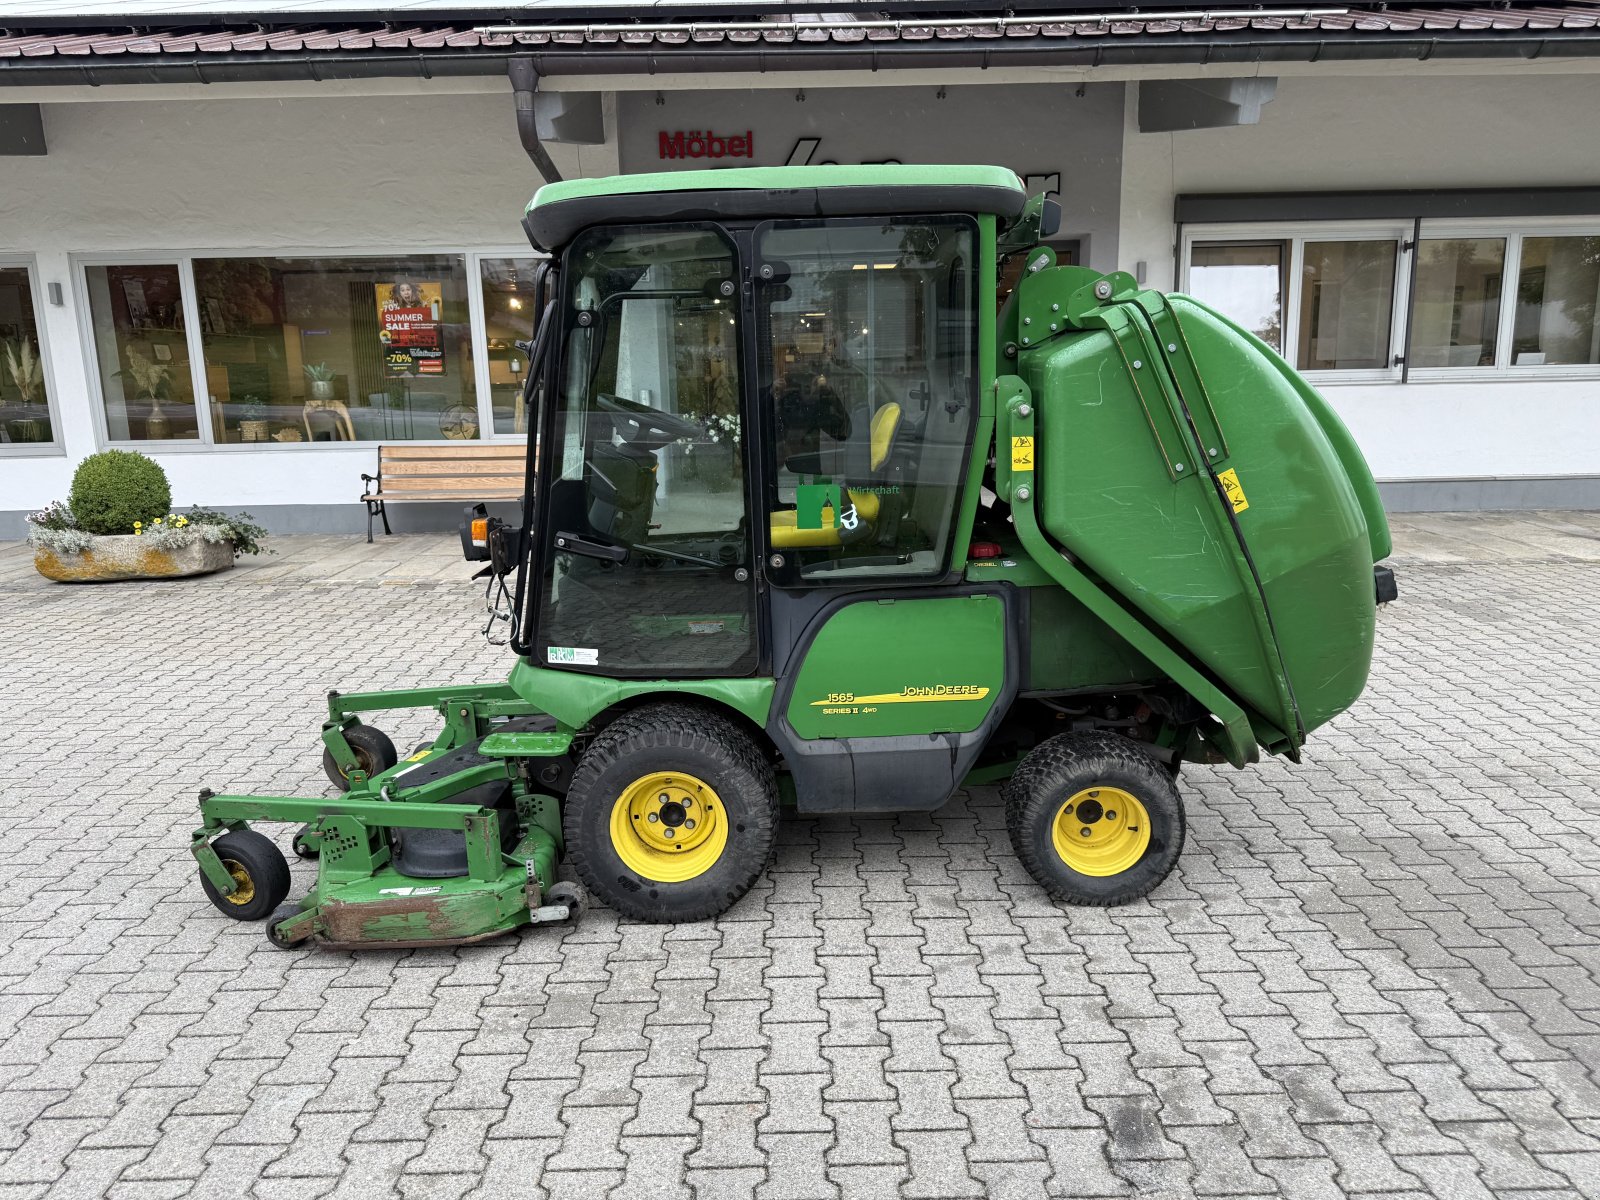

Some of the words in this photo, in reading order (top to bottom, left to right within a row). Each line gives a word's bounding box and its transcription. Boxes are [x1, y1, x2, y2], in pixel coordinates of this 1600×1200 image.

[659, 130, 753, 159] Möbel
[386, 354, 412, 363] -70%
[848, 485, 900, 495] Wirtschaft
[550, 653, 575, 662] RKM
[827, 693, 855, 703] 1565
[899, 686, 934, 697] JOHN
[935, 684, 979, 696] DEERE
